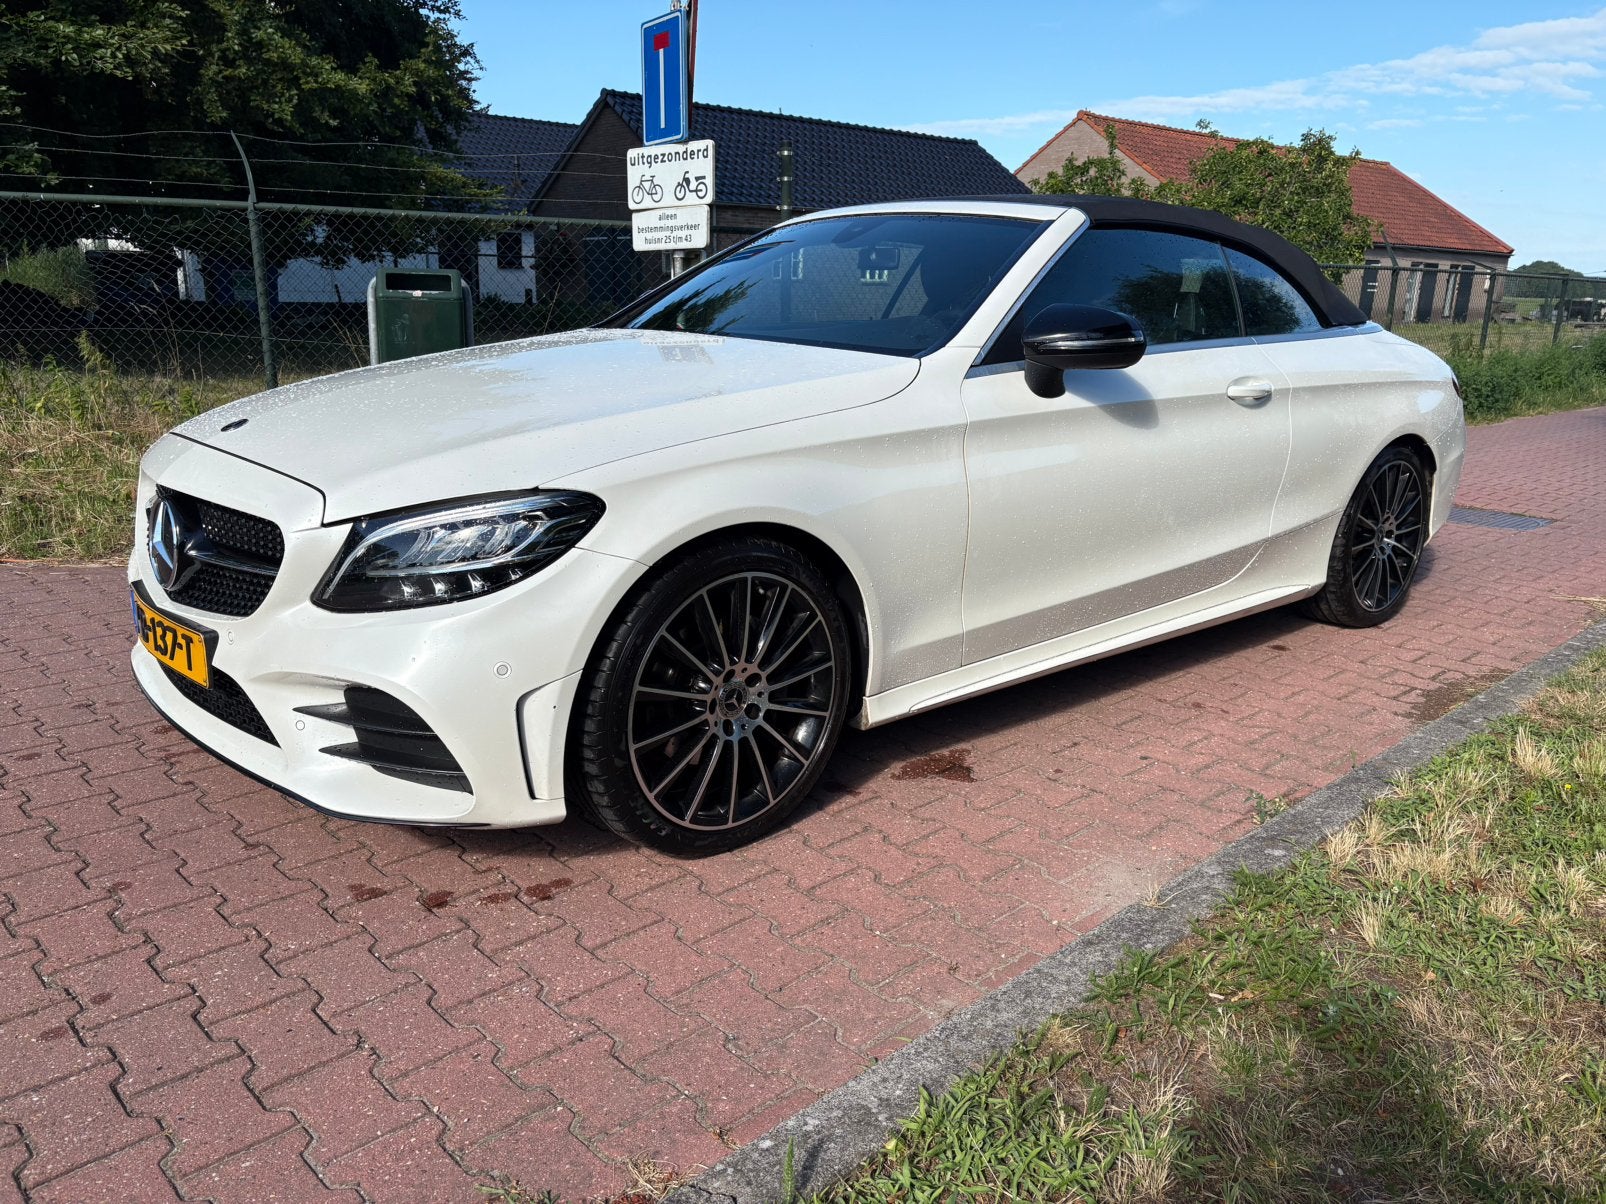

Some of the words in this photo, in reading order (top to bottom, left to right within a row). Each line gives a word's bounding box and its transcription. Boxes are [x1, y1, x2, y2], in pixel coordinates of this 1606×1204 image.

[630, 145, 709, 168] uitgezonderd
[658, 212, 677, 221] alleen
[637, 223, 701, 235] bestemmingsverkeer
[645, 236, 663, 245] huisnr
[664, 235, 672, 244] 25
[673, 235, 683, 245] t/m
[684, 234, 692, 243] 43
[137, 604, 194, 671] -137-T
